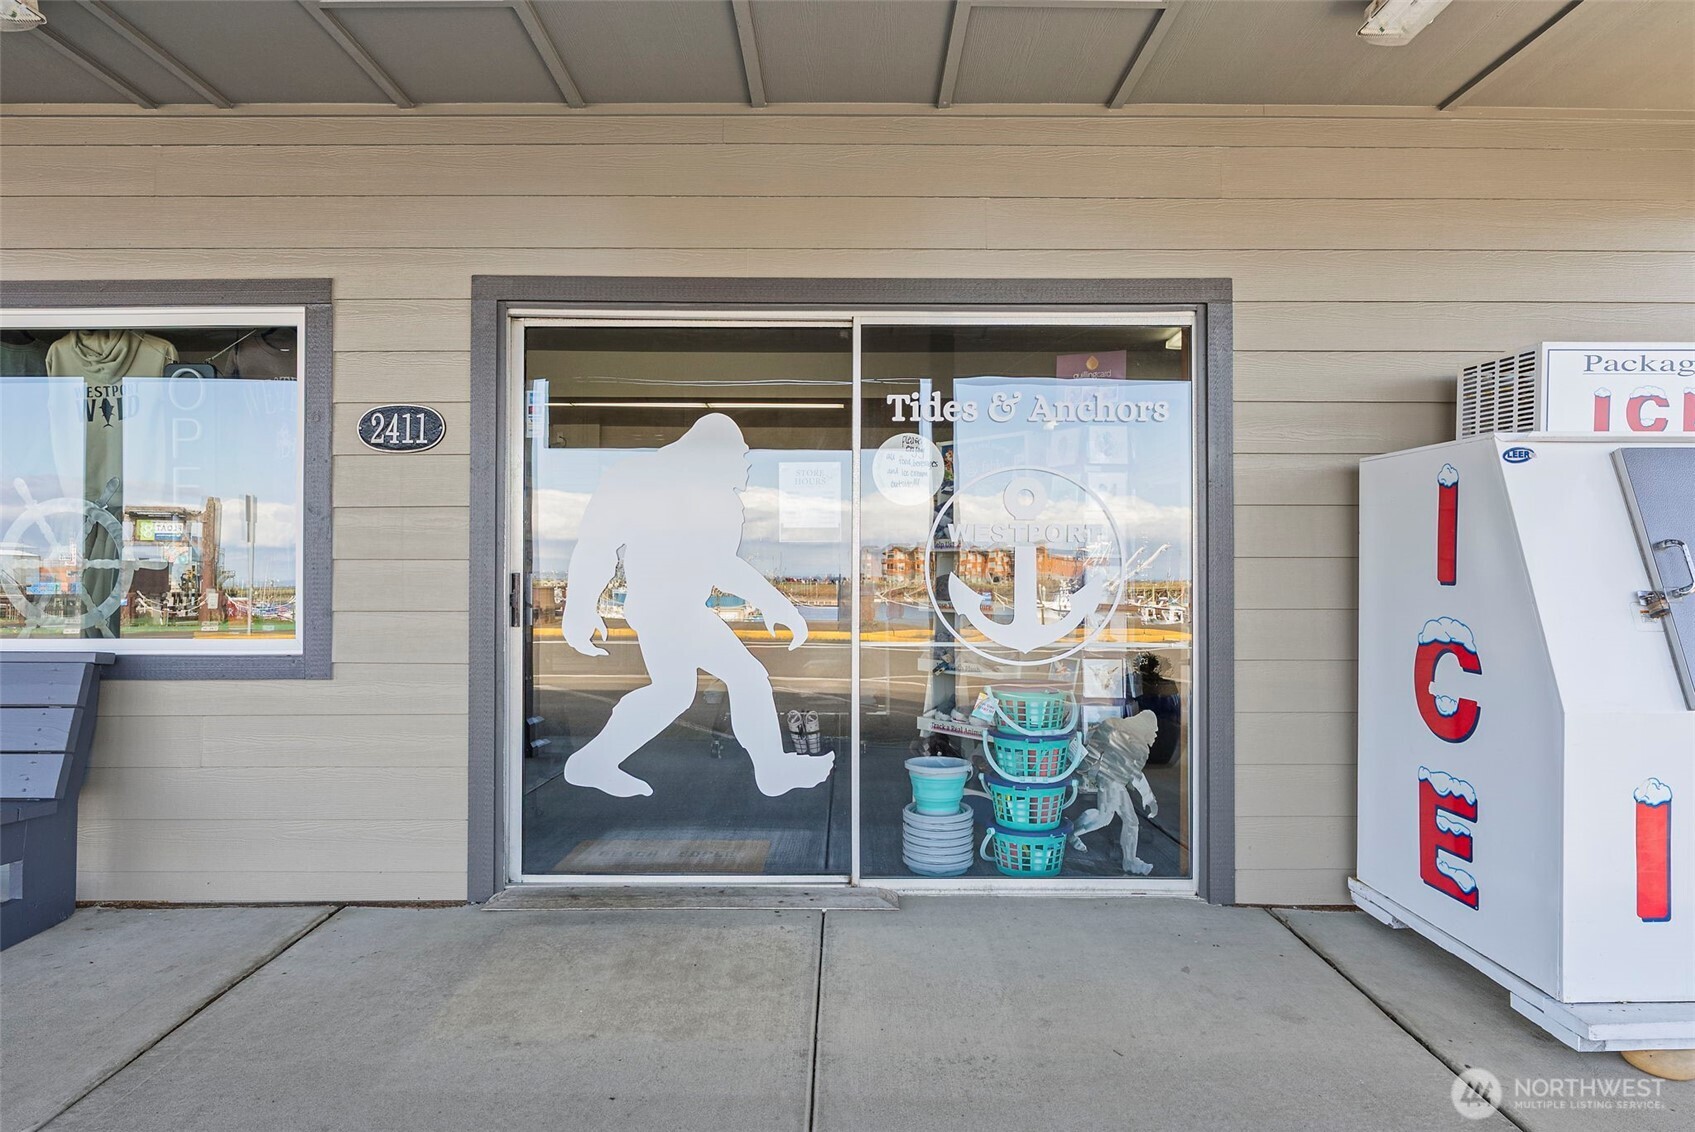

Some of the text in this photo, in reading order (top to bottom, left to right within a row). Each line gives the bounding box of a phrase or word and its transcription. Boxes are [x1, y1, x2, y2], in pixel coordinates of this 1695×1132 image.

[886, 391, 1170, 423] Tides & Anchors
[370, 412, 428, 444] 2411
[1507, 450, 1530, 459] LEER
[794, 477, 826, 486] HOURS
[796, 469, 825, 477] STORE
[947, 523, 1105, 543] WESTPORT
[1414, 463, 1482, 911] ICE
